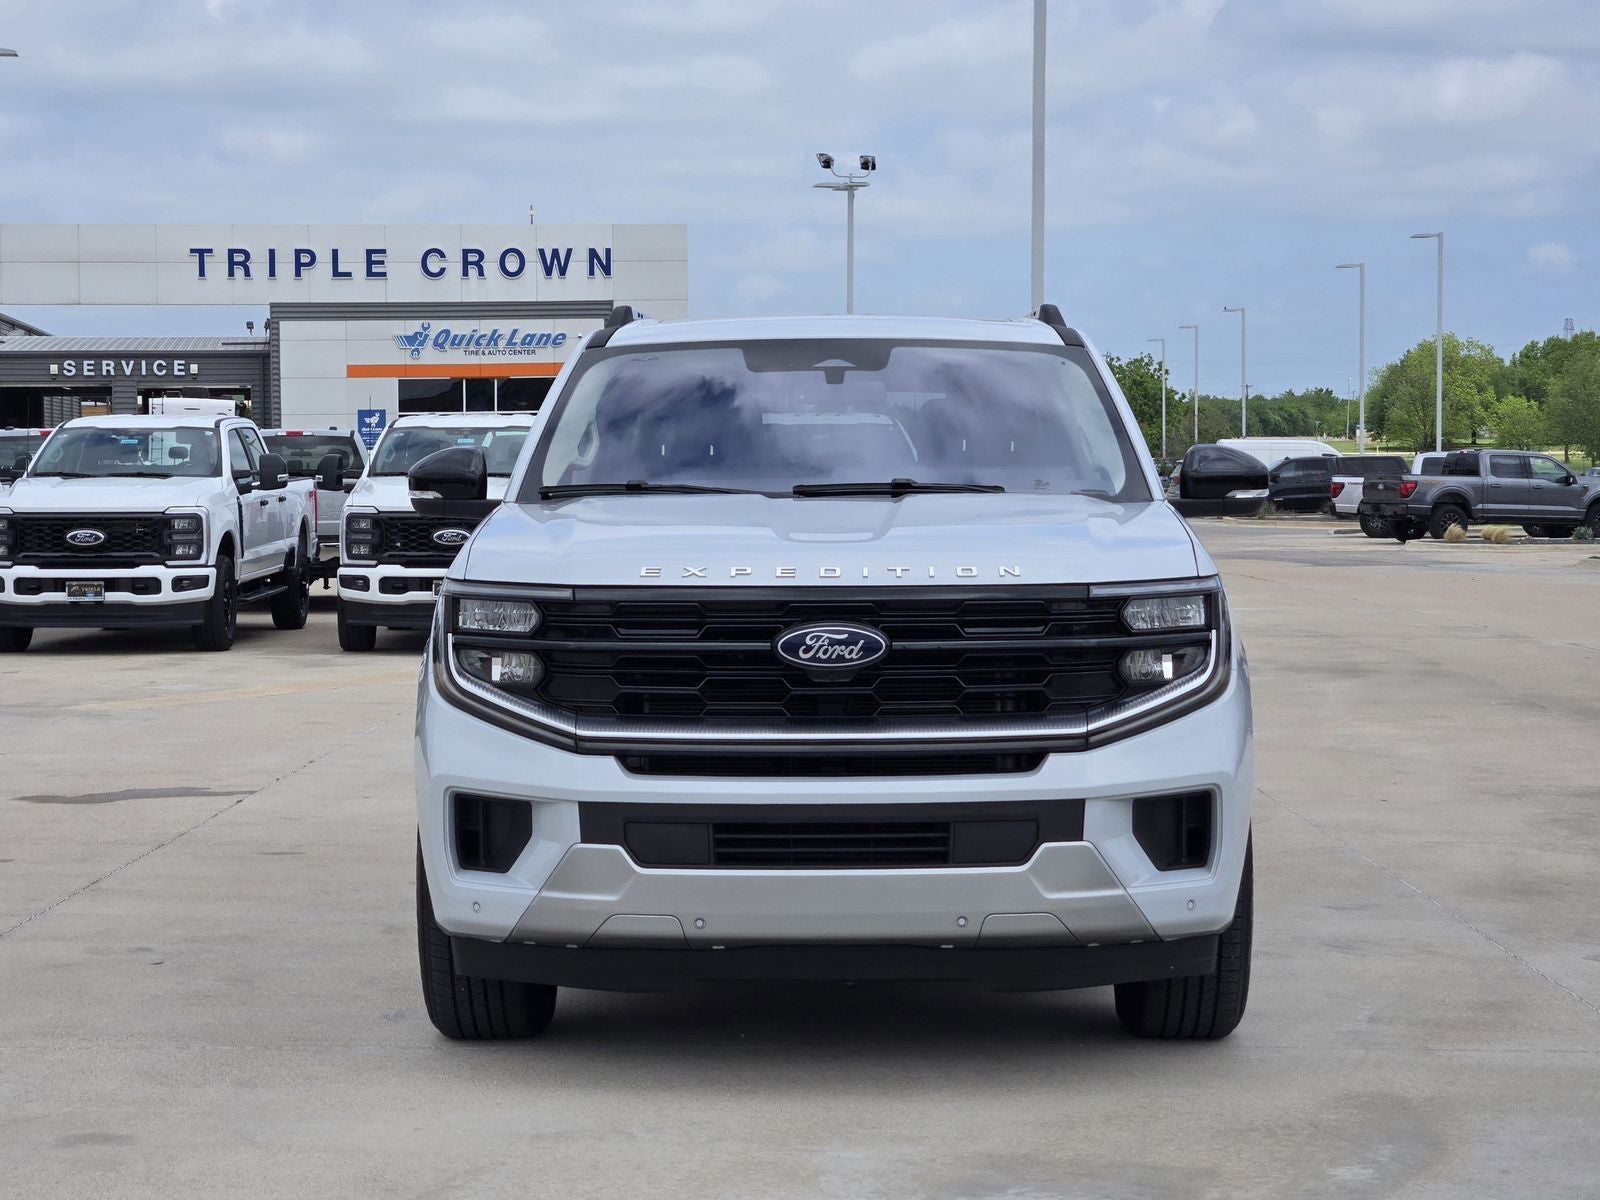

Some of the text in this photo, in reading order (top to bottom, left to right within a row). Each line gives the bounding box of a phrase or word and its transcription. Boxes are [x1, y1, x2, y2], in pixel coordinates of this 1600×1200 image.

[189, 247, 613, 280] TRIPLE CROWN
[432, 328, 567, 352] Quick Lane
[463, 349, 480, 357] TIRE
[62, 359, 186, 377] SERVICE
[639, 565, 1022, 579] EXPEDITION
[798, 632, 863, 661] Ford
